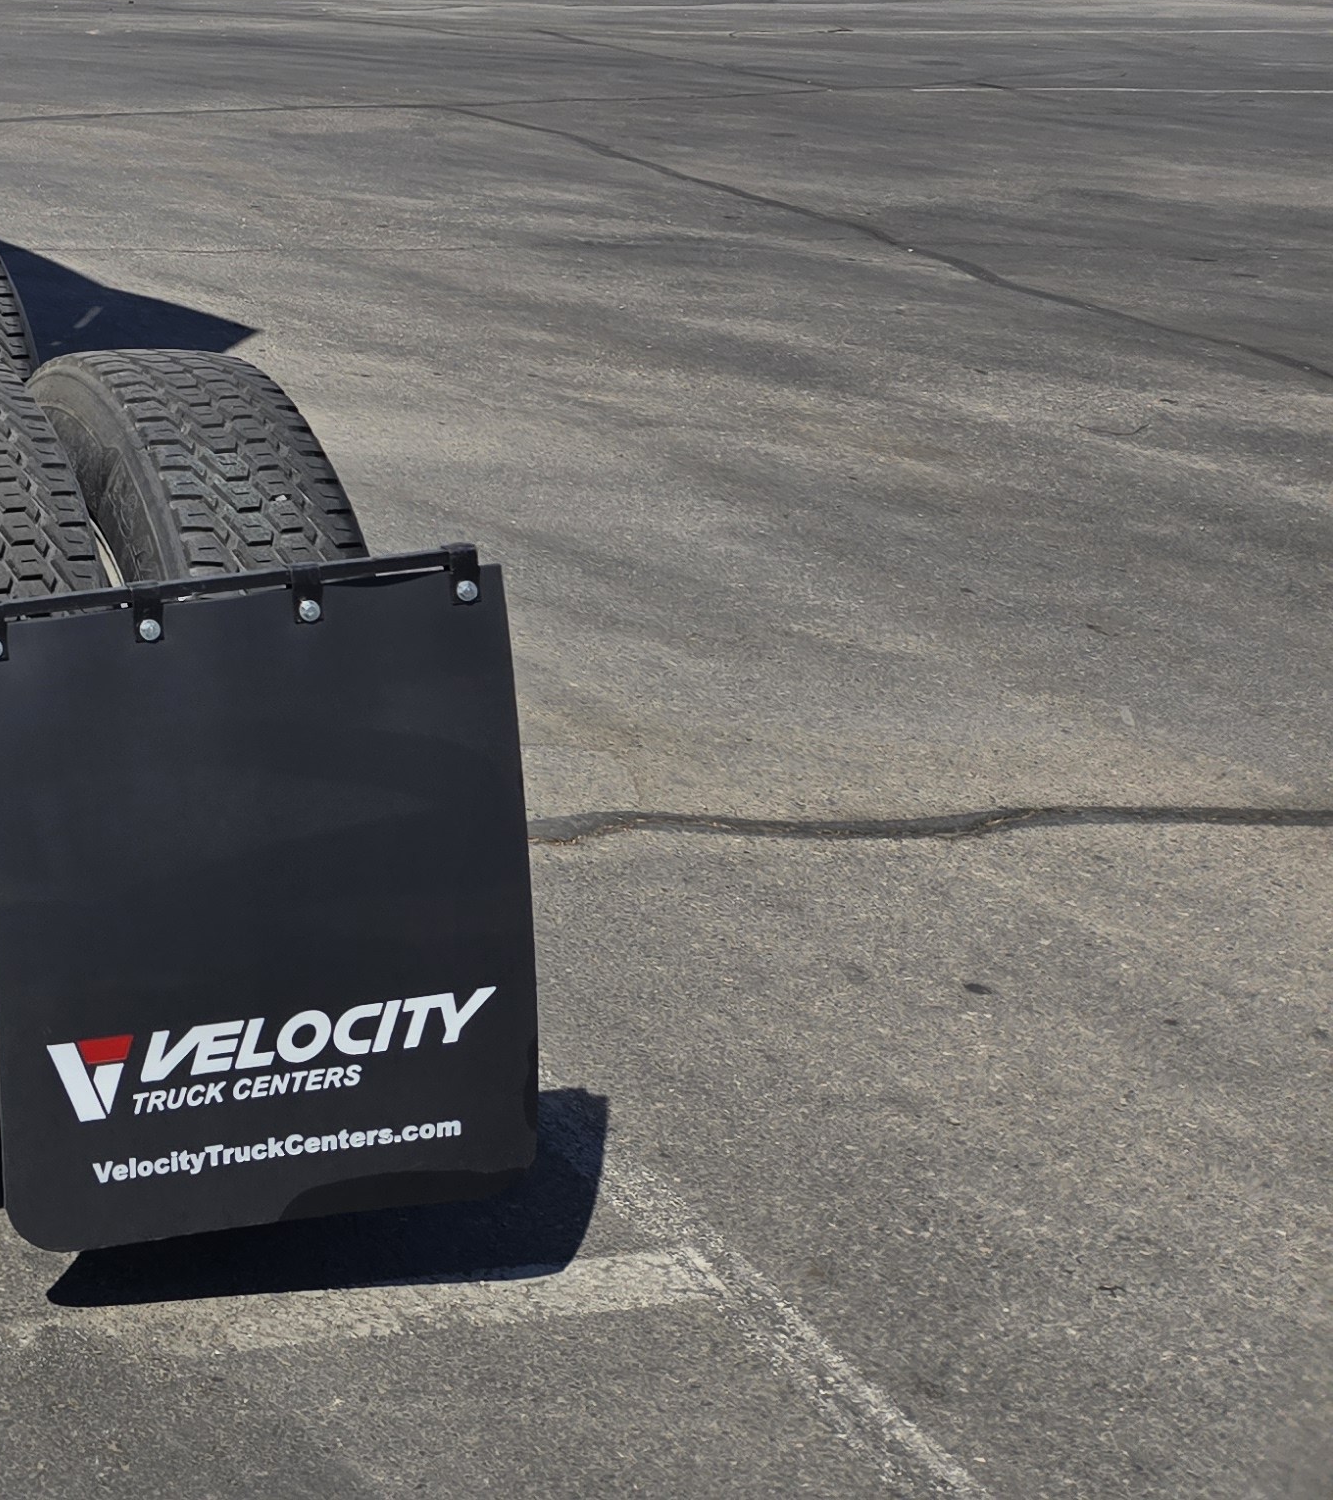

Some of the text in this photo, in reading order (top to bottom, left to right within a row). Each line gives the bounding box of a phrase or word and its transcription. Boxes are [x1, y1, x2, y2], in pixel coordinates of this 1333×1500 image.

[140, 985, 497, 1083] VELOCITY
[132, 1064, 363, 1115] TRUCK CENTERS
[92, 1119, 462, 1184] VelocityTruckCenters.com
